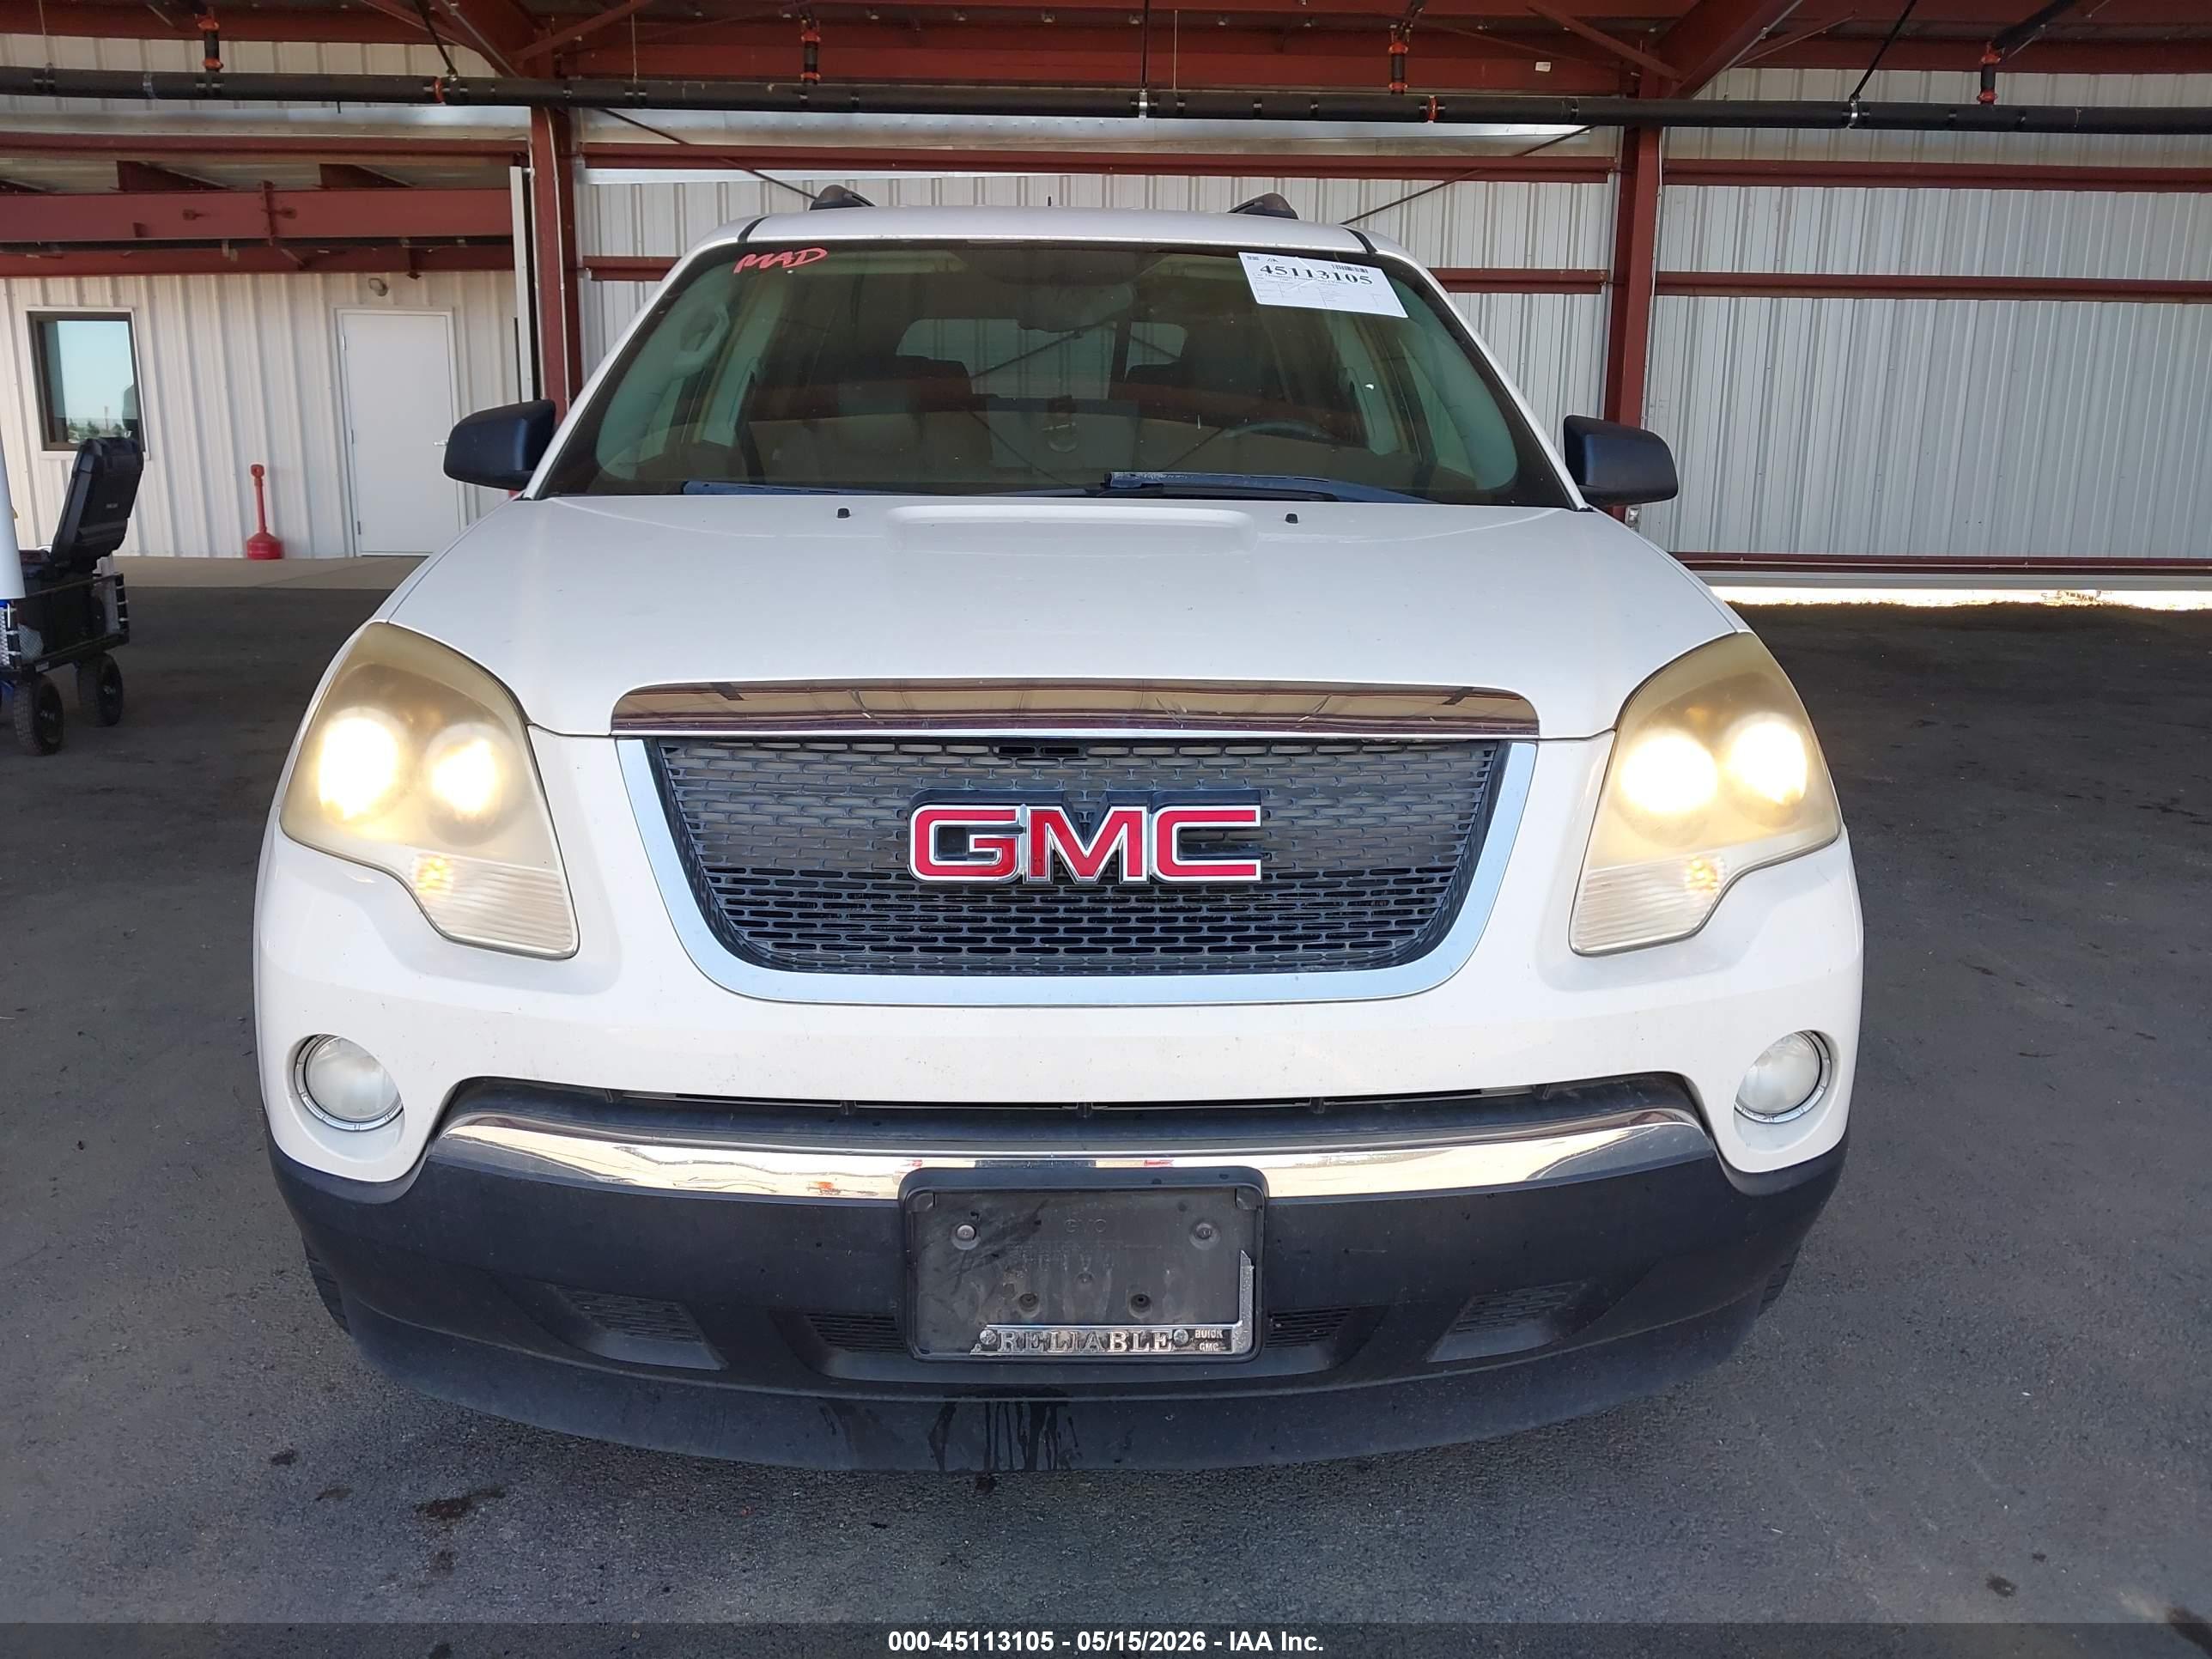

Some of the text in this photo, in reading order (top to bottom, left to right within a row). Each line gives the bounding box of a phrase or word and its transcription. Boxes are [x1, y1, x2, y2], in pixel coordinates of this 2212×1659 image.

[1260, 264, 1372, 285] 45113105
[908, 804, 1262, 885] GMC
[998, 1328, 1174, 1353] RELIABLE
[1194, 1328, 1224, 1339] BUICK
